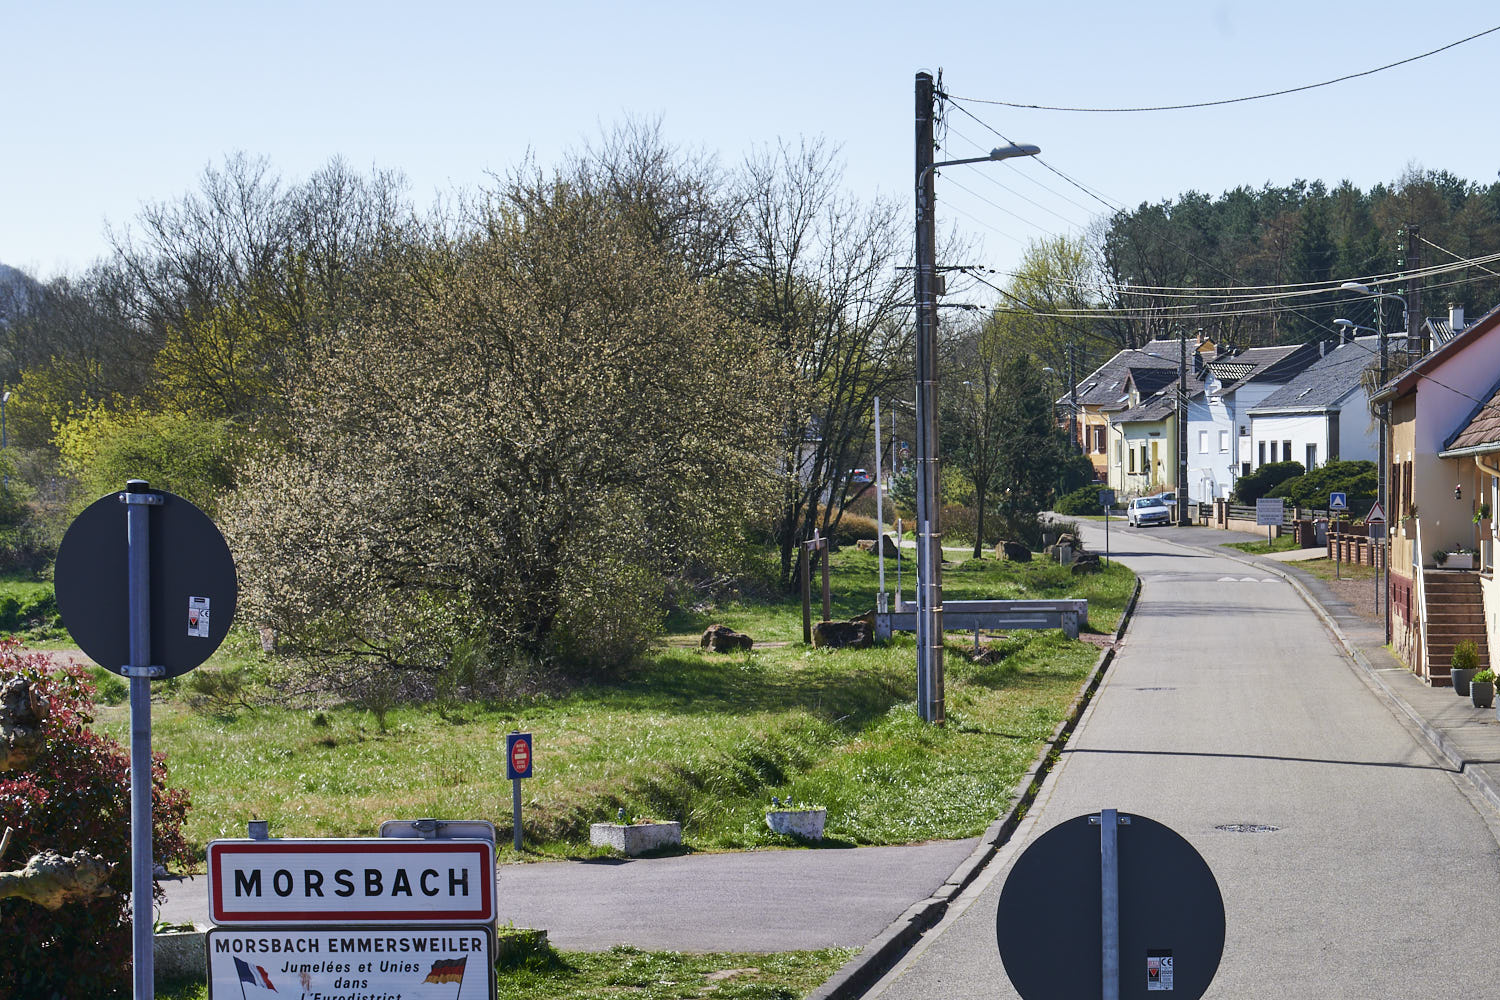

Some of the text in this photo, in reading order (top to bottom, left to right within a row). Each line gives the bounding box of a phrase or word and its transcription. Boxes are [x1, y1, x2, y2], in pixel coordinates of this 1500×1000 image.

[234, 868, 469, 898] MORSBACH
[215, 937, 482, 954] MORSBACH EMMERSWEILER
[281, 960, 420, 973] Jumelées et Unies
[334, 977, 368, 989] dans
